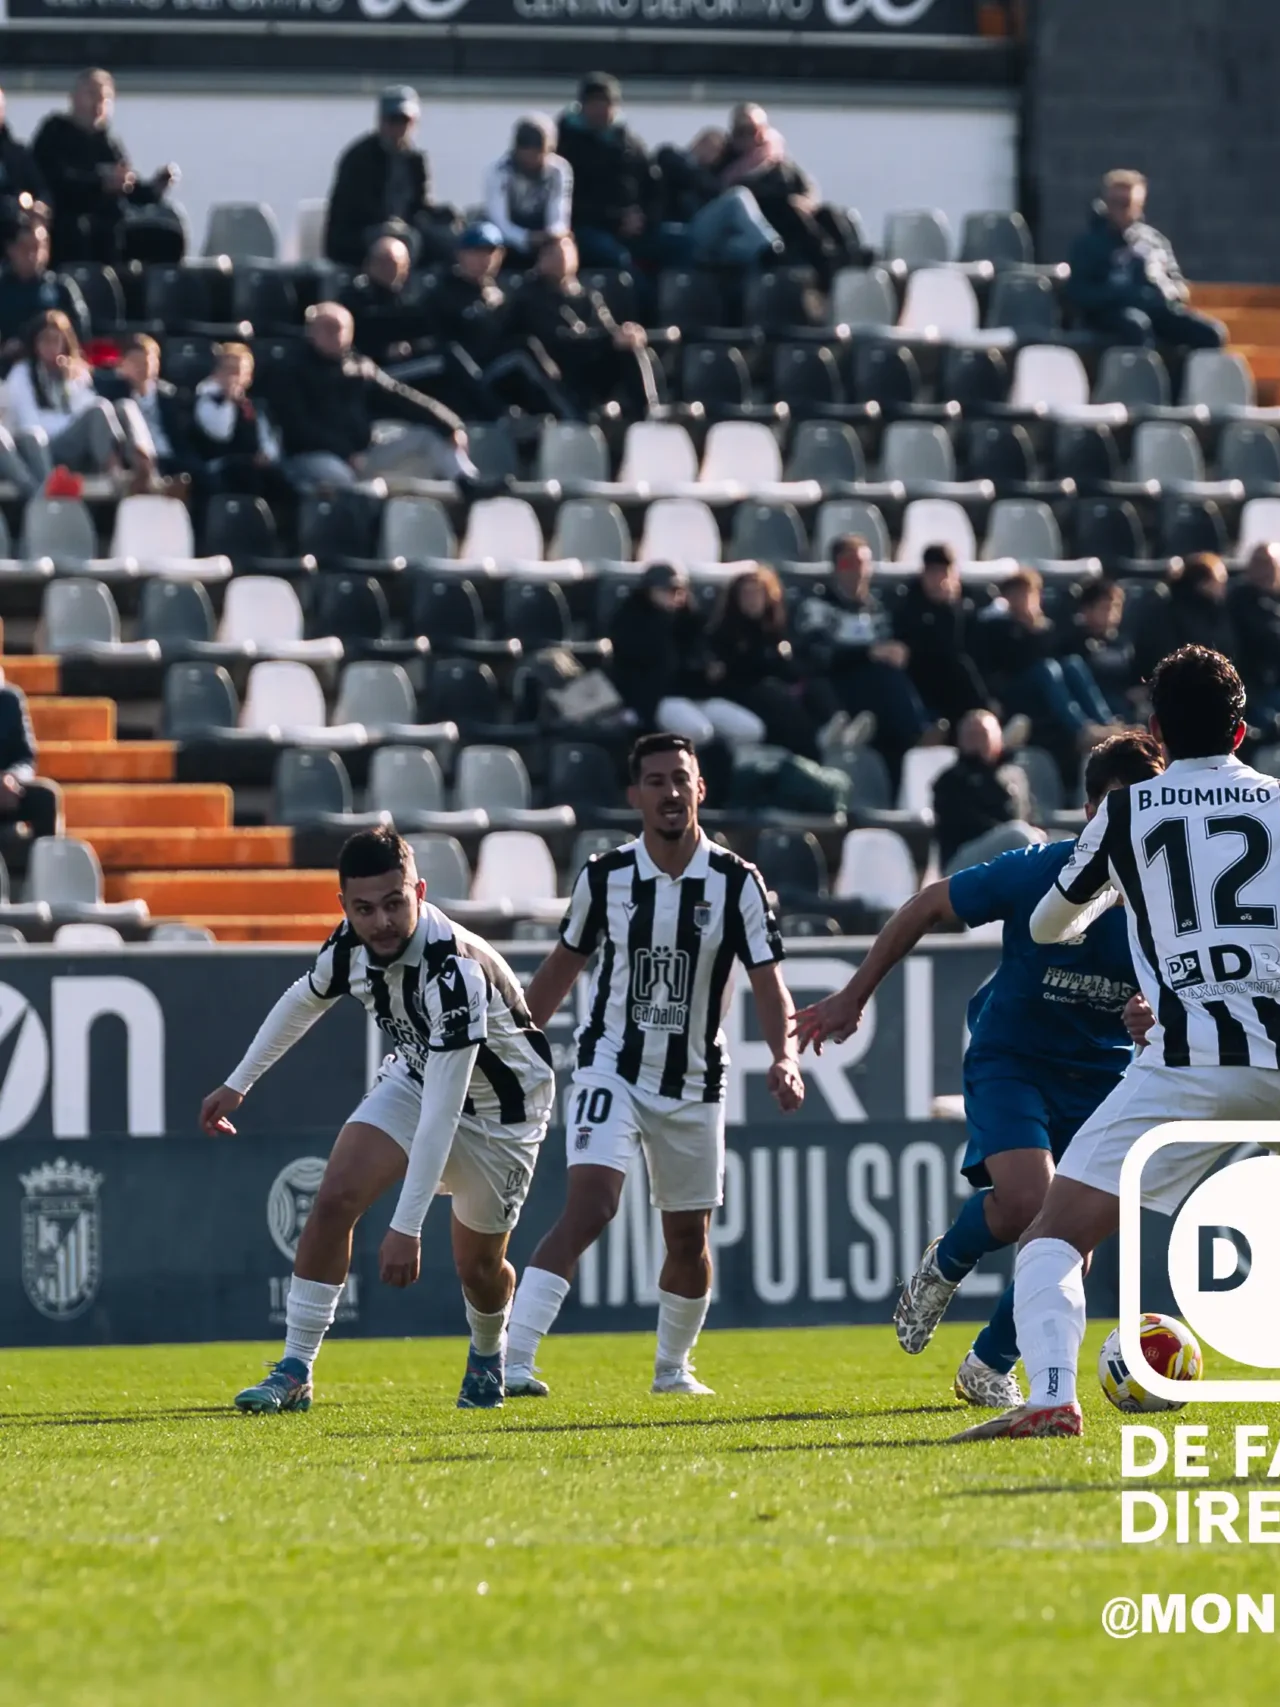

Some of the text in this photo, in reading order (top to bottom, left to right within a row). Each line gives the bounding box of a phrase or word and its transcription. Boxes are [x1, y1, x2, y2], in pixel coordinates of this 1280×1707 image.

[1138, 786, 1271, 811] B.DOMINGO
[1141, 812, 1278, 938] 12
[575, 1086, 614, 1125] 10
